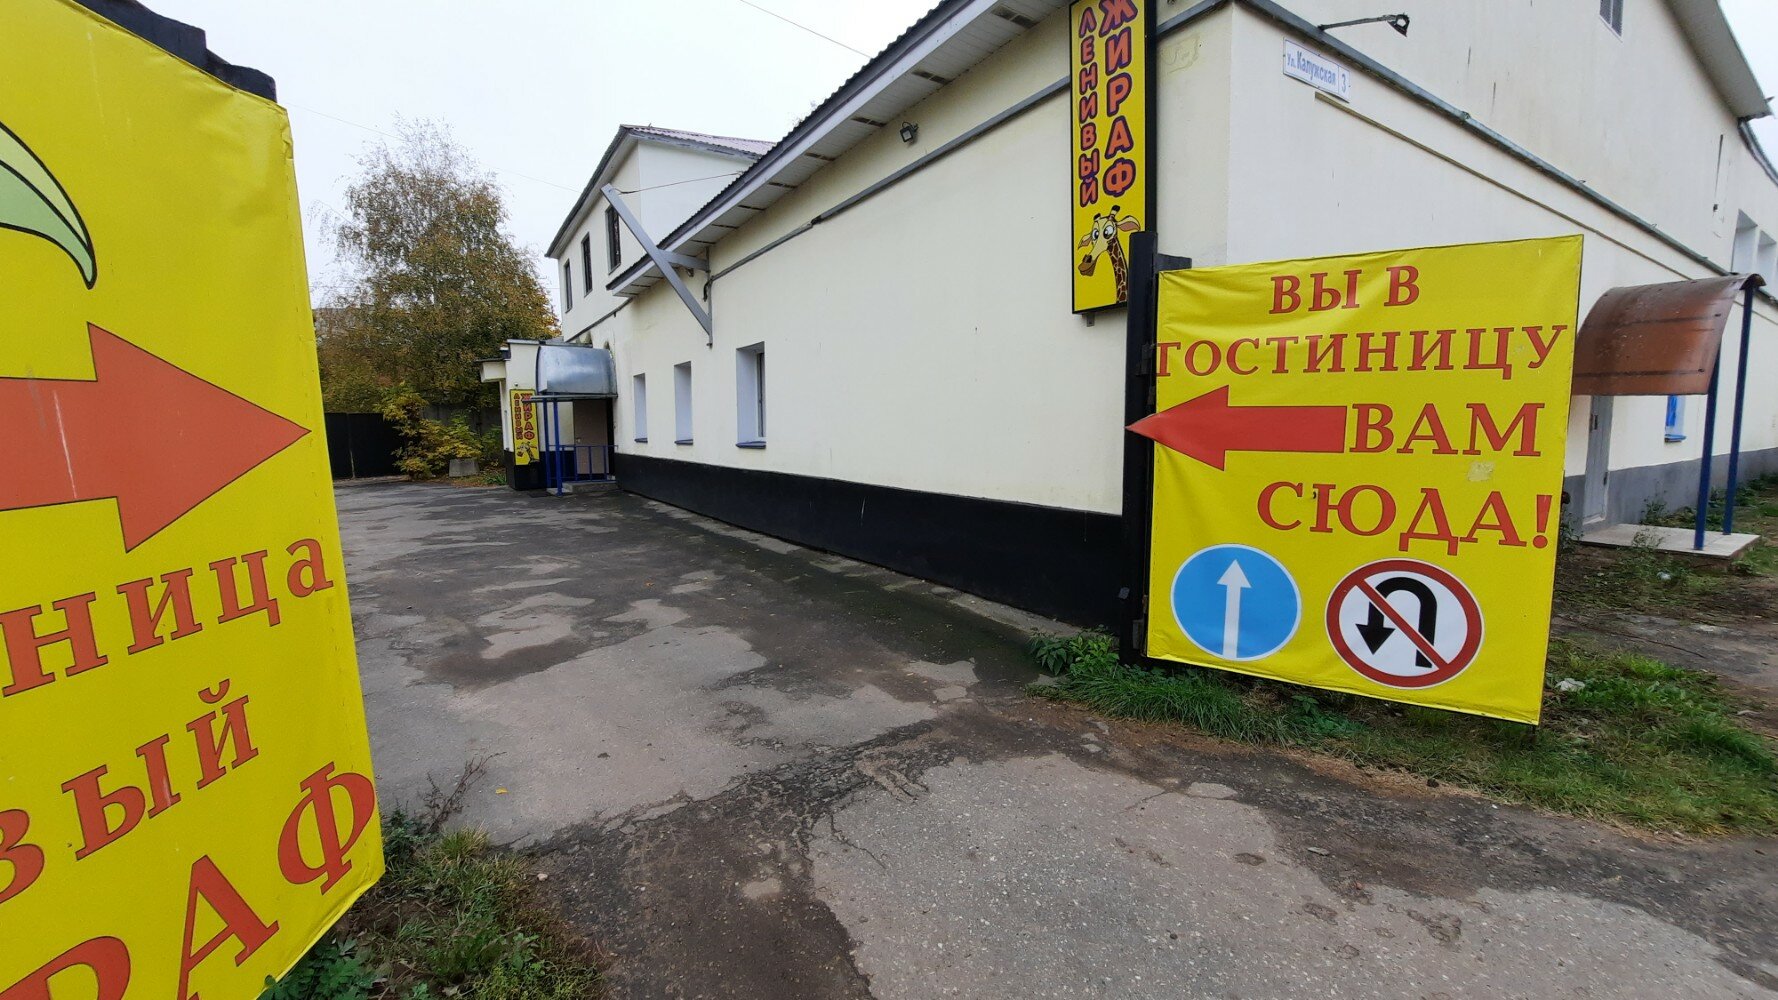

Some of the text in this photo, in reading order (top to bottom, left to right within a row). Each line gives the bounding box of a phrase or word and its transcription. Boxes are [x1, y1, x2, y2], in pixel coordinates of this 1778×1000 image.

[1098, 0, 1138, 197] ЖИРАФ
[1296, 51, 1336, 86] Калужская
[1342, 73, 1347, 93] 3
[1078, 6, 1099, 208] ЛЕНИВЫЙ
[1269, 265, 1420, 314] ВЫ В
[1156, 324, 1567, 380] ГОСТИНИЦУ
[1349, 403, 1545, 457] ВАМ
[1257, 481, 1553, 556] СЮДА!
